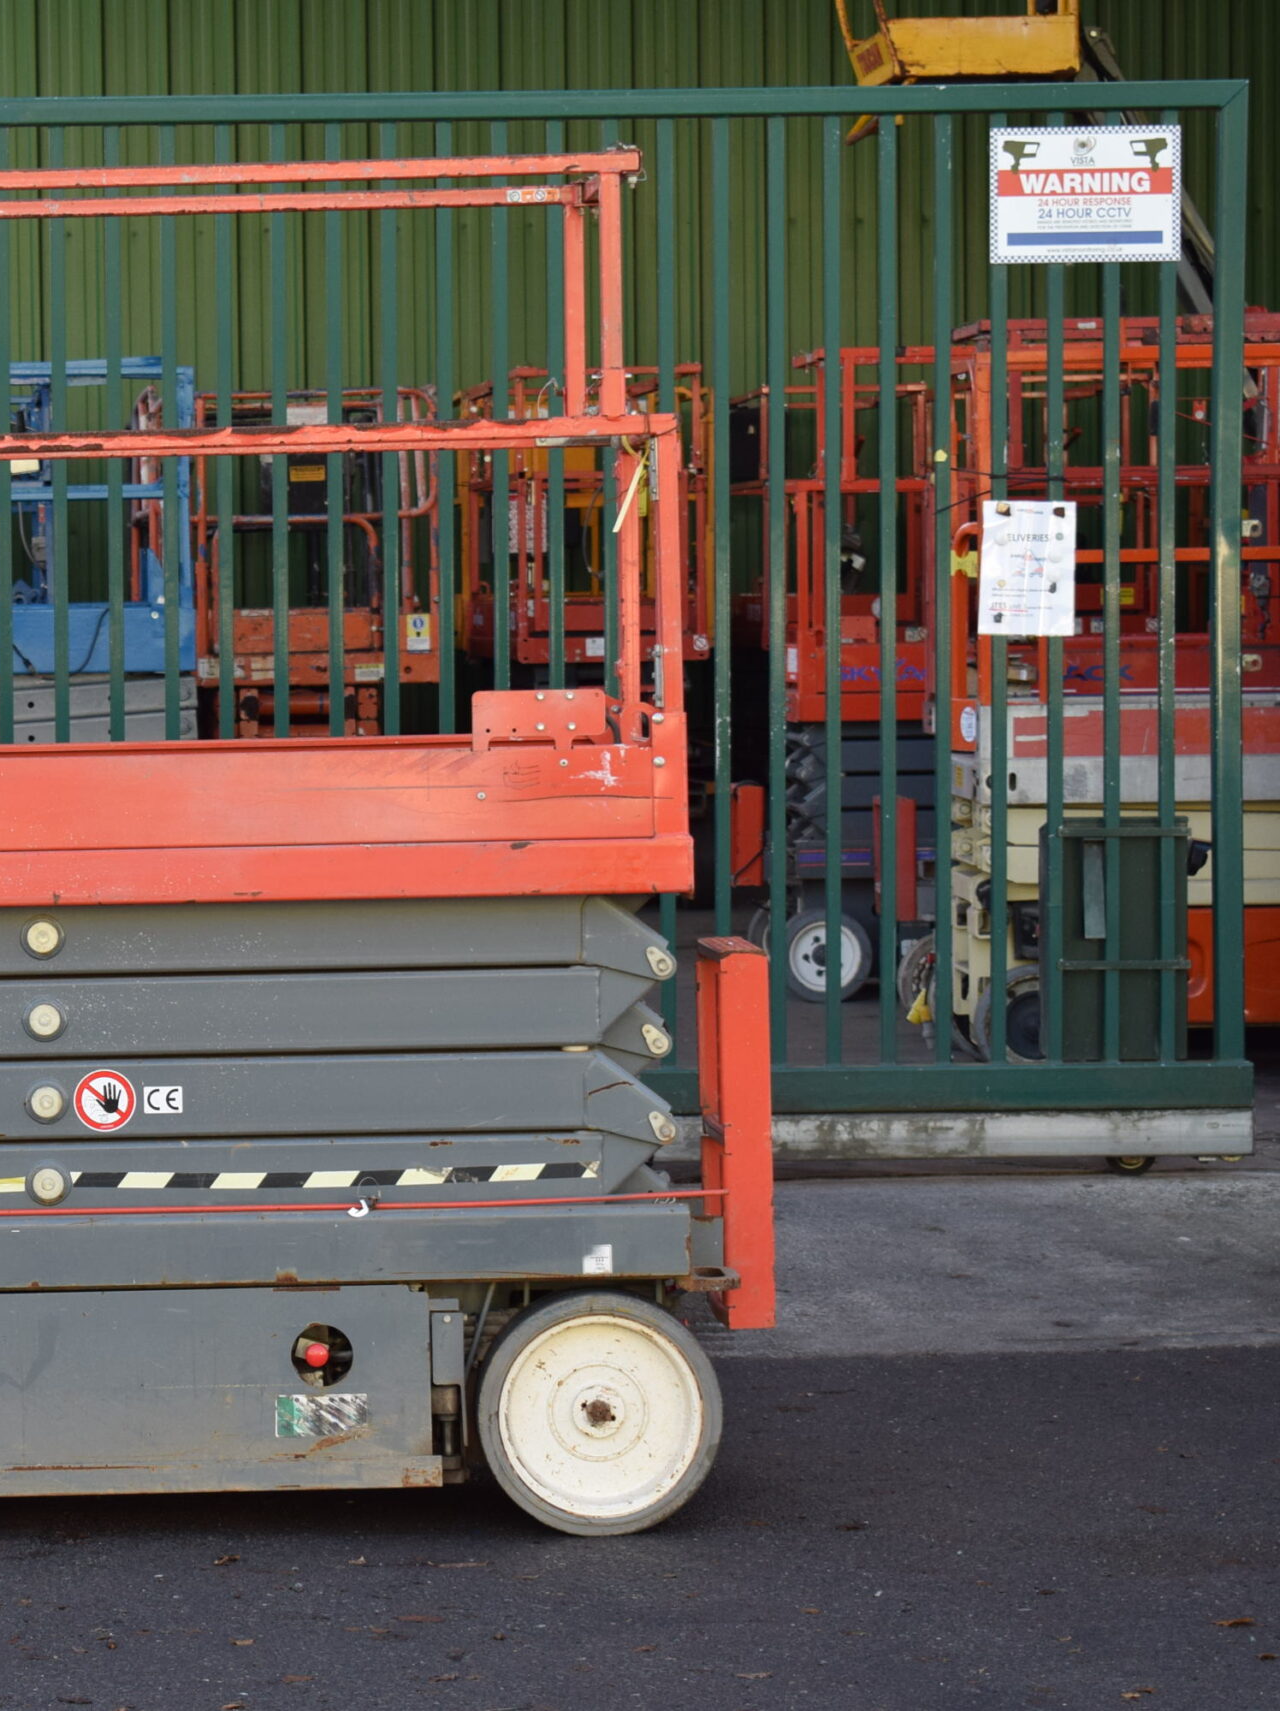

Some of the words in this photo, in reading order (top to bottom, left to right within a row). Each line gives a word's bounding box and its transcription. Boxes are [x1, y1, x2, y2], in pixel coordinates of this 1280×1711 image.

[1070, 156, 1095, 165] VISTA
[1019, 171, 1151, 194] WARNING
[1038, 198, 1049, 207] 24
[1052, 198, 1079, 207] HOUR
[1083, 197, 1132, 206] RESPONSE
[1038, 208, 1052, 219] 24
[1057, 208, 1093, 218] HOUR
[1096, 207, 1132, 218] CCTV
[1006, 533, 1049, 542] ELIVERIES
[147, 1088, 179, 1110] CE
